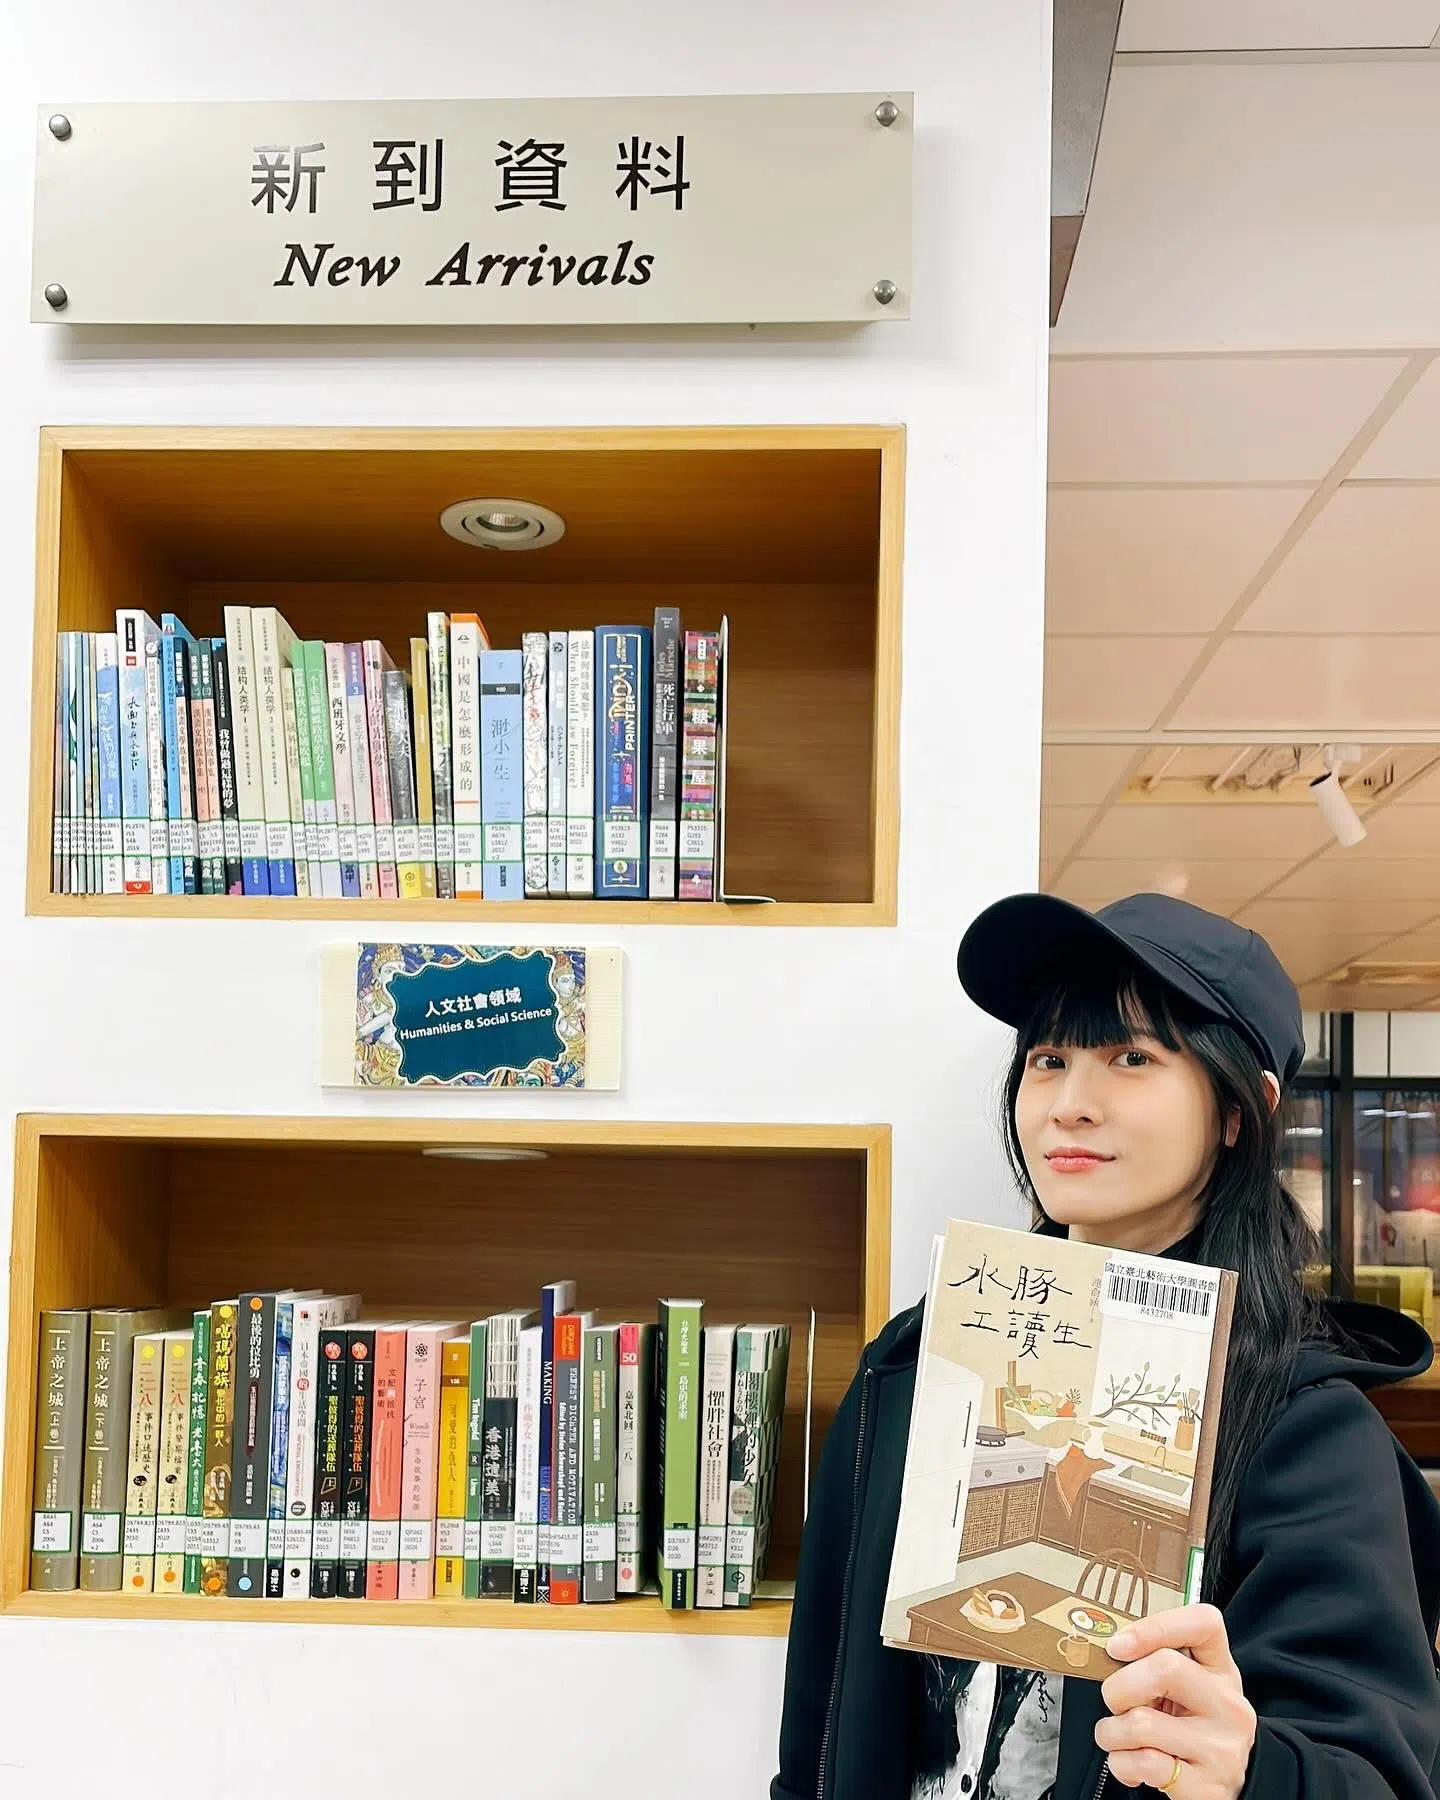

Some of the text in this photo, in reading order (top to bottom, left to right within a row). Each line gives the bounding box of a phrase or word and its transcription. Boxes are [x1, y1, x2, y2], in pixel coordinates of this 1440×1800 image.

[251, 136, 690, 214] 新到資料
[274, 241, 654, 286] New Arrivals
[570, 641, 579, 673] When
[570, 677, 579, 714] Should
[457, 655, 473, 792] 中國是怎麼形成的
[569, 717, 579, 740] Law
[625, 695, 636, 751] PAINTER
[691, 708, 709, 785] 糖果屋
[425, 986, 522, 1018] 人文社會領域
[400, 1006, 552, 1040] Humanities & Social Science
[947, 1254, 1073, 1304] 水豚
[1104, 1261, 1218, 1293] 國立臺北藝術大學圖書館
[1140, 1306, 1174, 1320] 8432708
[961, 1309, 1092, 1360] 工讀生
[622, 1352, 637, 1362] 50
[413, 1379, 427, 1409] 子宮
[543, 1361, 552, 1405] MAKING
[470, 1398, 480, 1441] Tim Ingold
[566, 1367, 577, 1525] ERNEST DICHTER AND MOTIVATION
[470, 1478, 478, 1496] Lines
